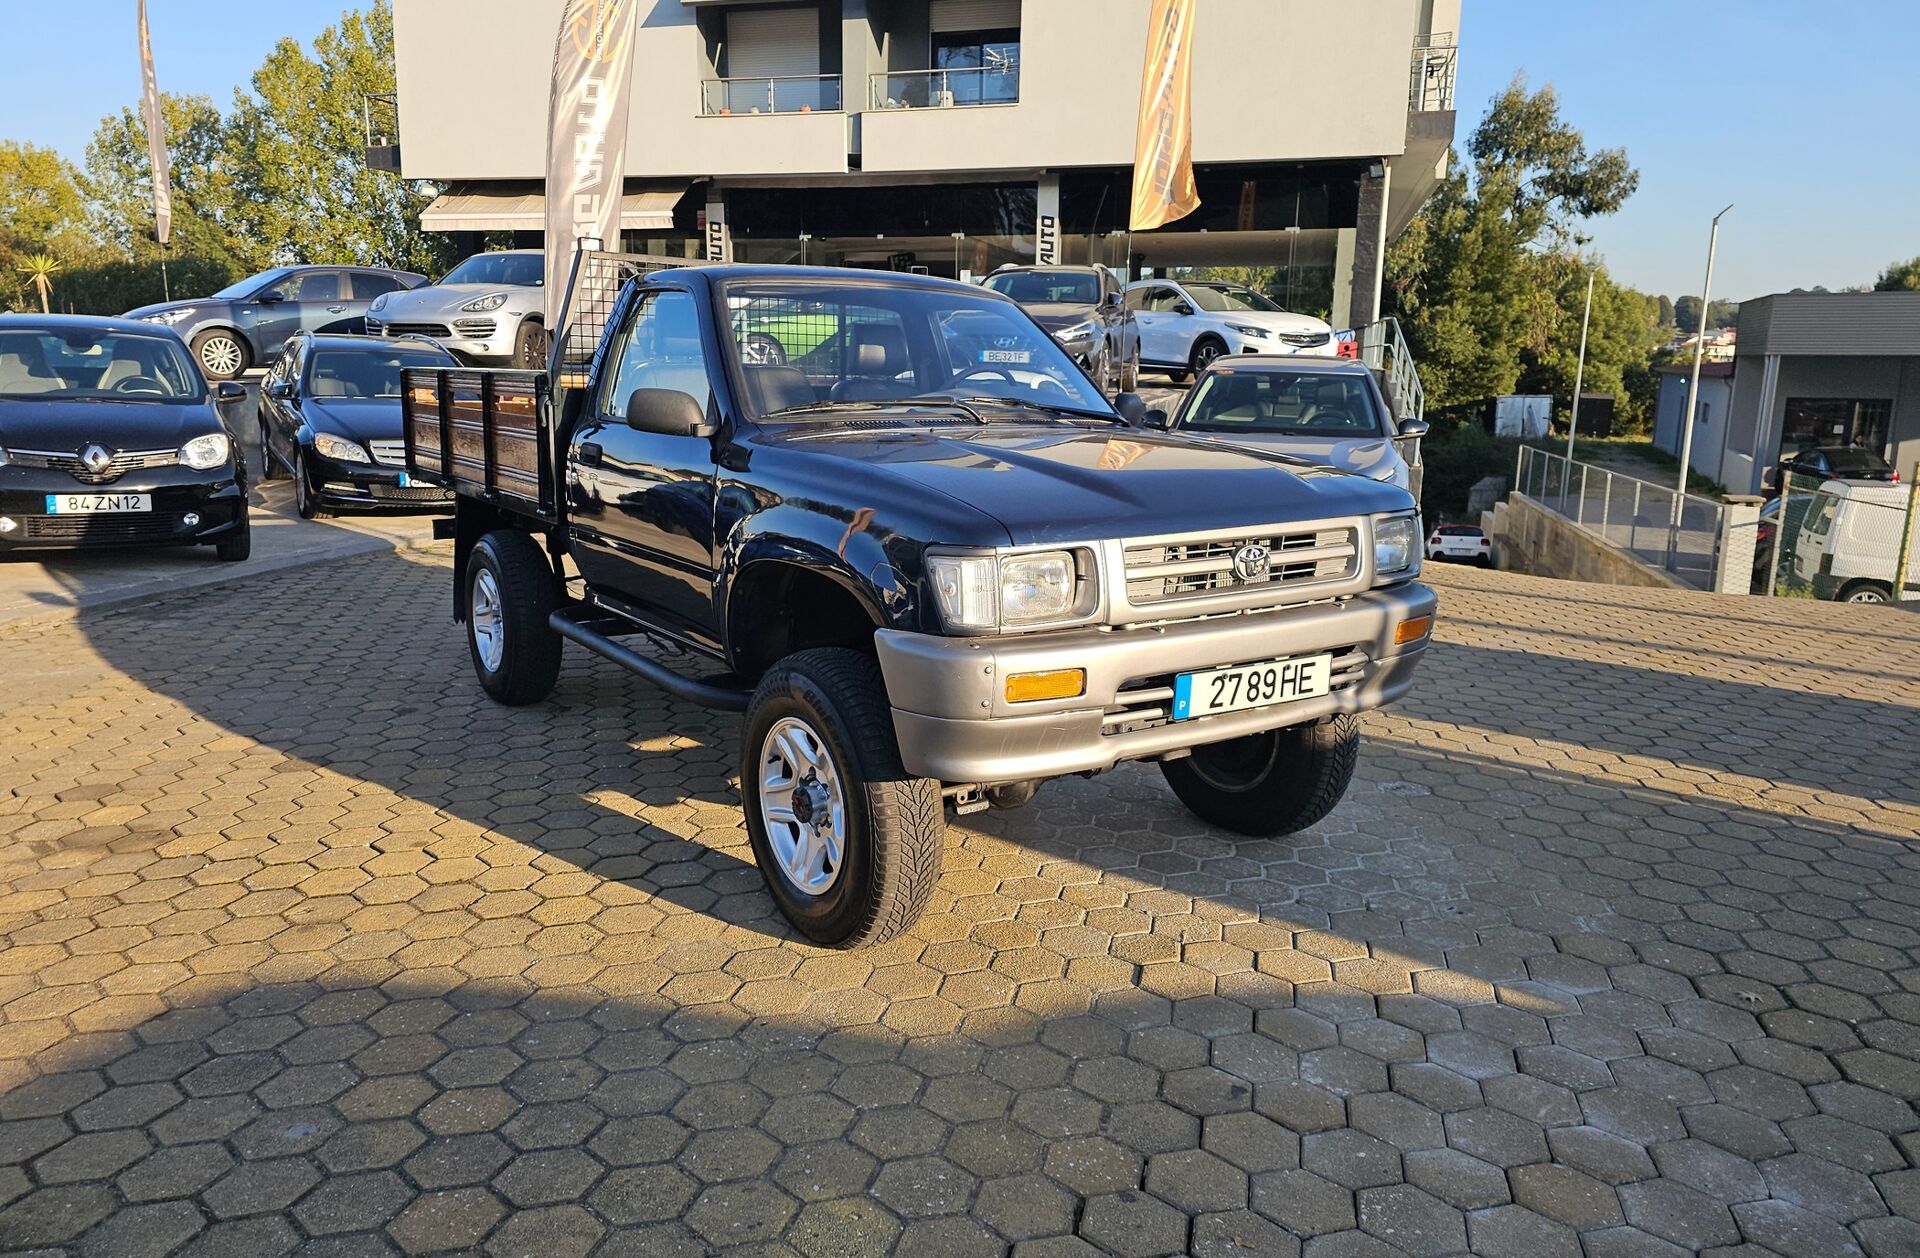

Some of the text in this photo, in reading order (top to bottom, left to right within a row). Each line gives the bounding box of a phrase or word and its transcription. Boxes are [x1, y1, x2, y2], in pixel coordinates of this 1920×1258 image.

[1154, 8, 1180, 206] JORGATO
[1040, 215, 1055, 265] AUTO
[1179, 700, 1186, 711] P
